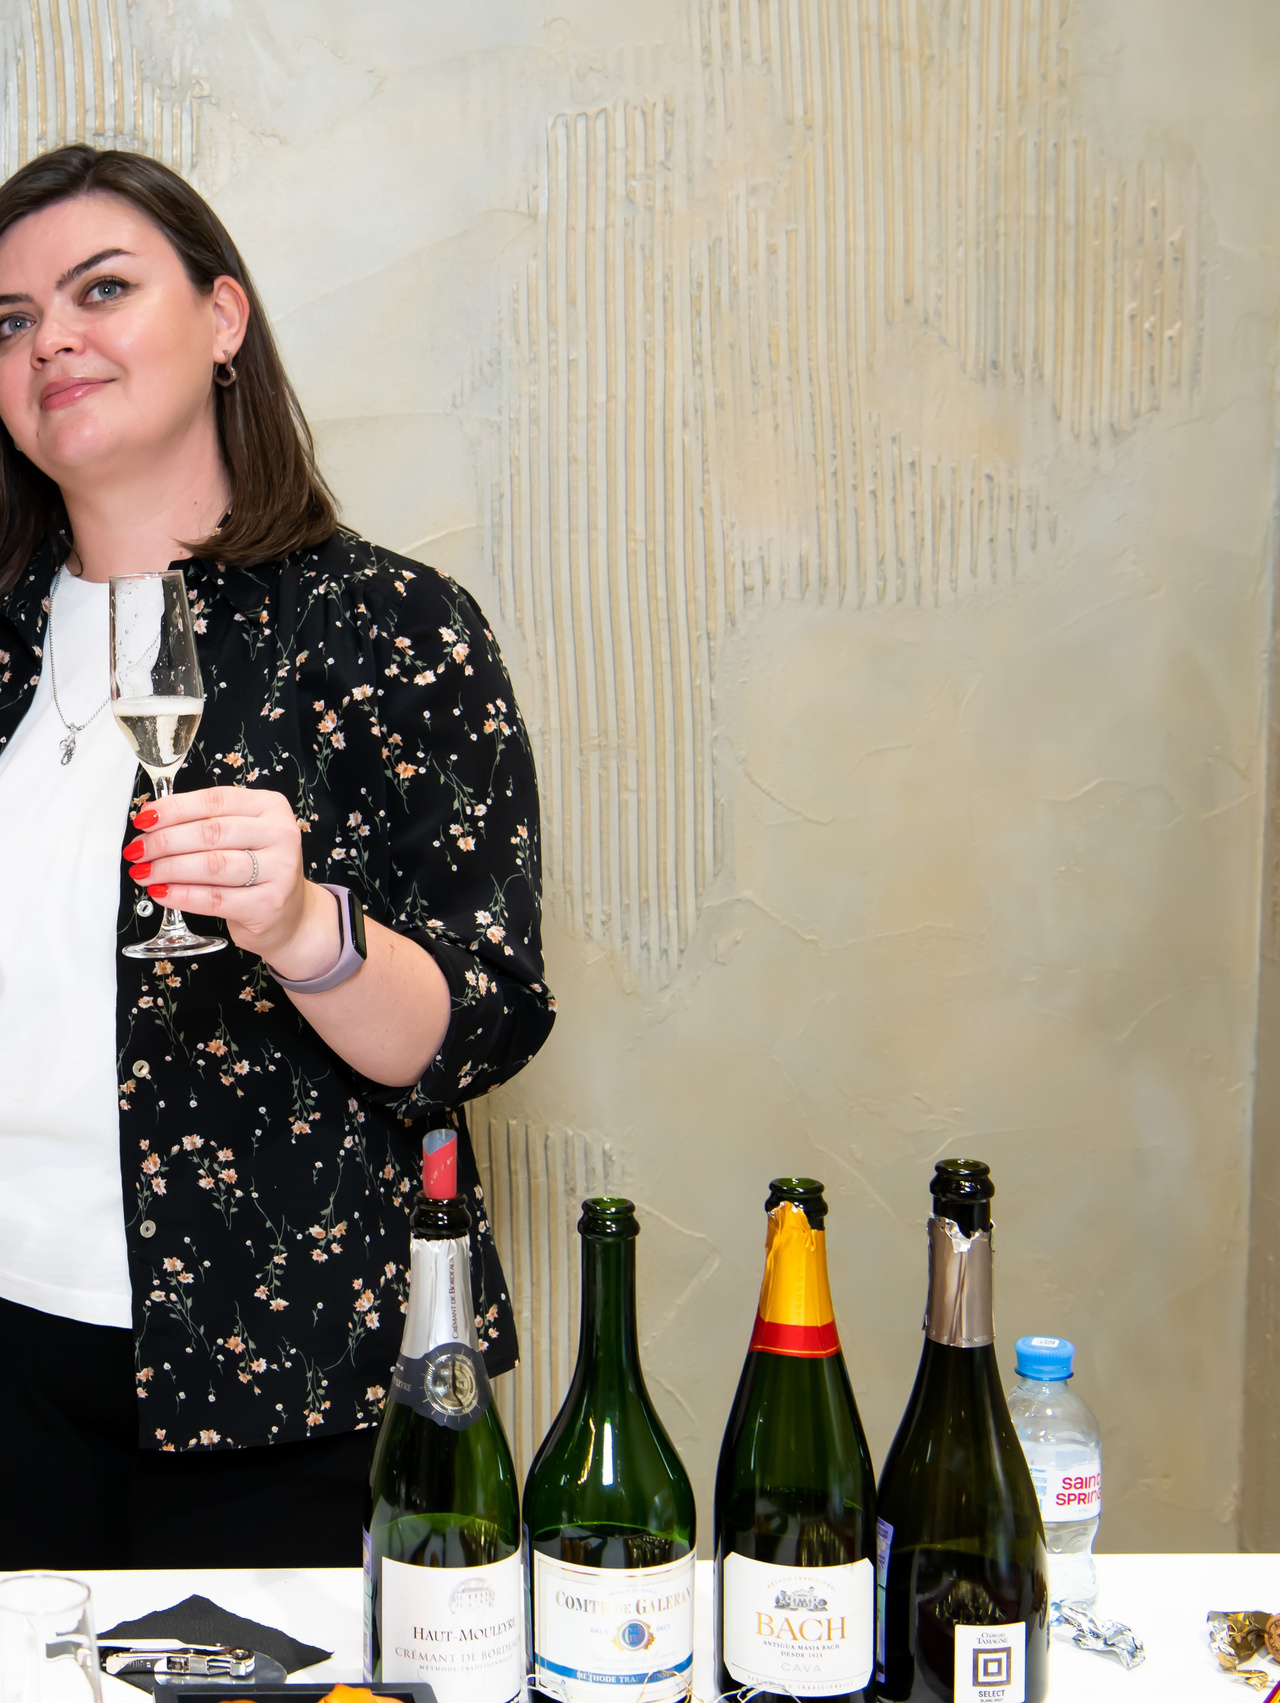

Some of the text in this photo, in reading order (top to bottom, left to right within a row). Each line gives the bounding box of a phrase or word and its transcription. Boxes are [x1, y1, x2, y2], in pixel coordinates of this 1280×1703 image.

[451, 1295, 457, 1305] DE
[451, 1306, 460, 1340] CRÉMANT
[656, 1623, 671, 1632] BRUT
[755, 1610, 847, 1641] BACH
[589, 1627, 609, 1635] BRUT
[763, 1640, 795, 1650] ANTIGUA
[461, 1652, 476, 1662] DE
[781, 1650, 805, 1658] DESDE
[781, 1662, 823, 1672] CAVA
